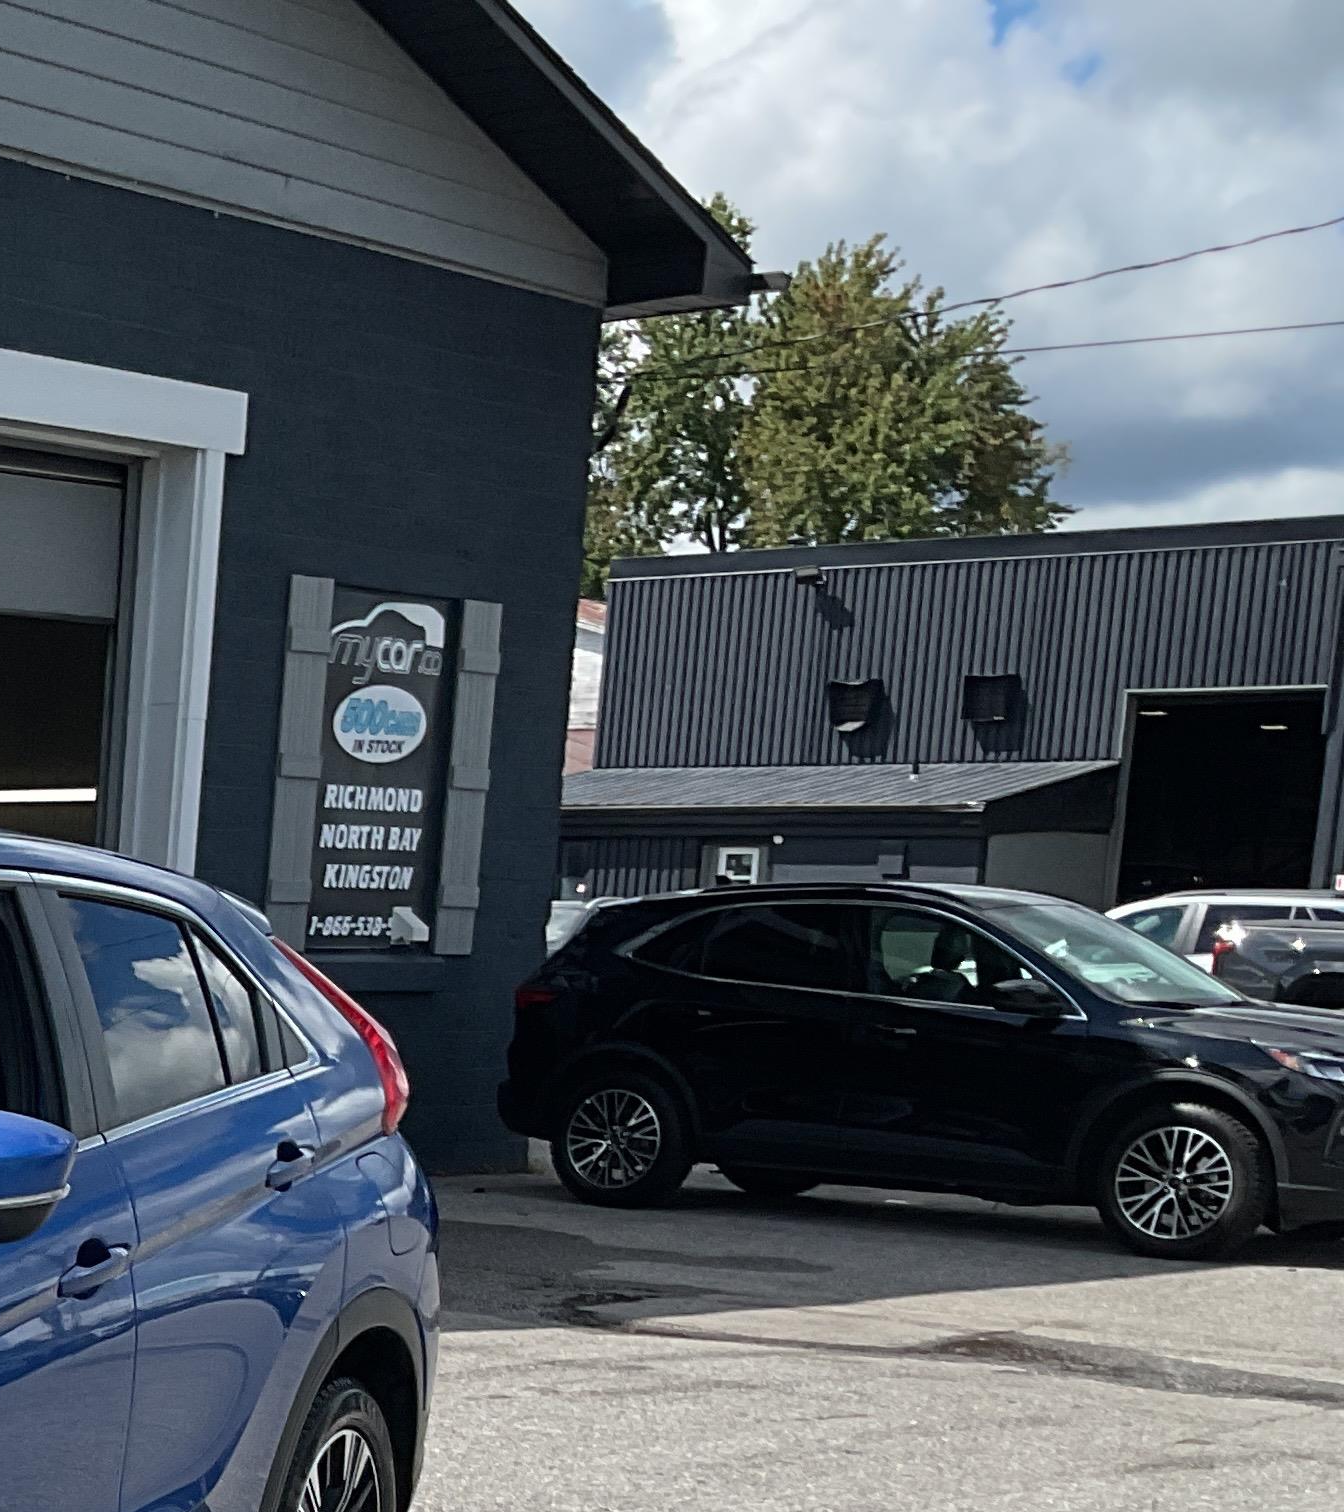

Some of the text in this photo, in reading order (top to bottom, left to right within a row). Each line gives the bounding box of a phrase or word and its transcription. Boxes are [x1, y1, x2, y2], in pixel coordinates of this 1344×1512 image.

[351, 739, 405, 754] IN STOCK
[323, 783, 423, 813] RICHMOND
[318, 823, 423, 852] NORTH BAY
[323, 863, 414, 891] KINGSTON
